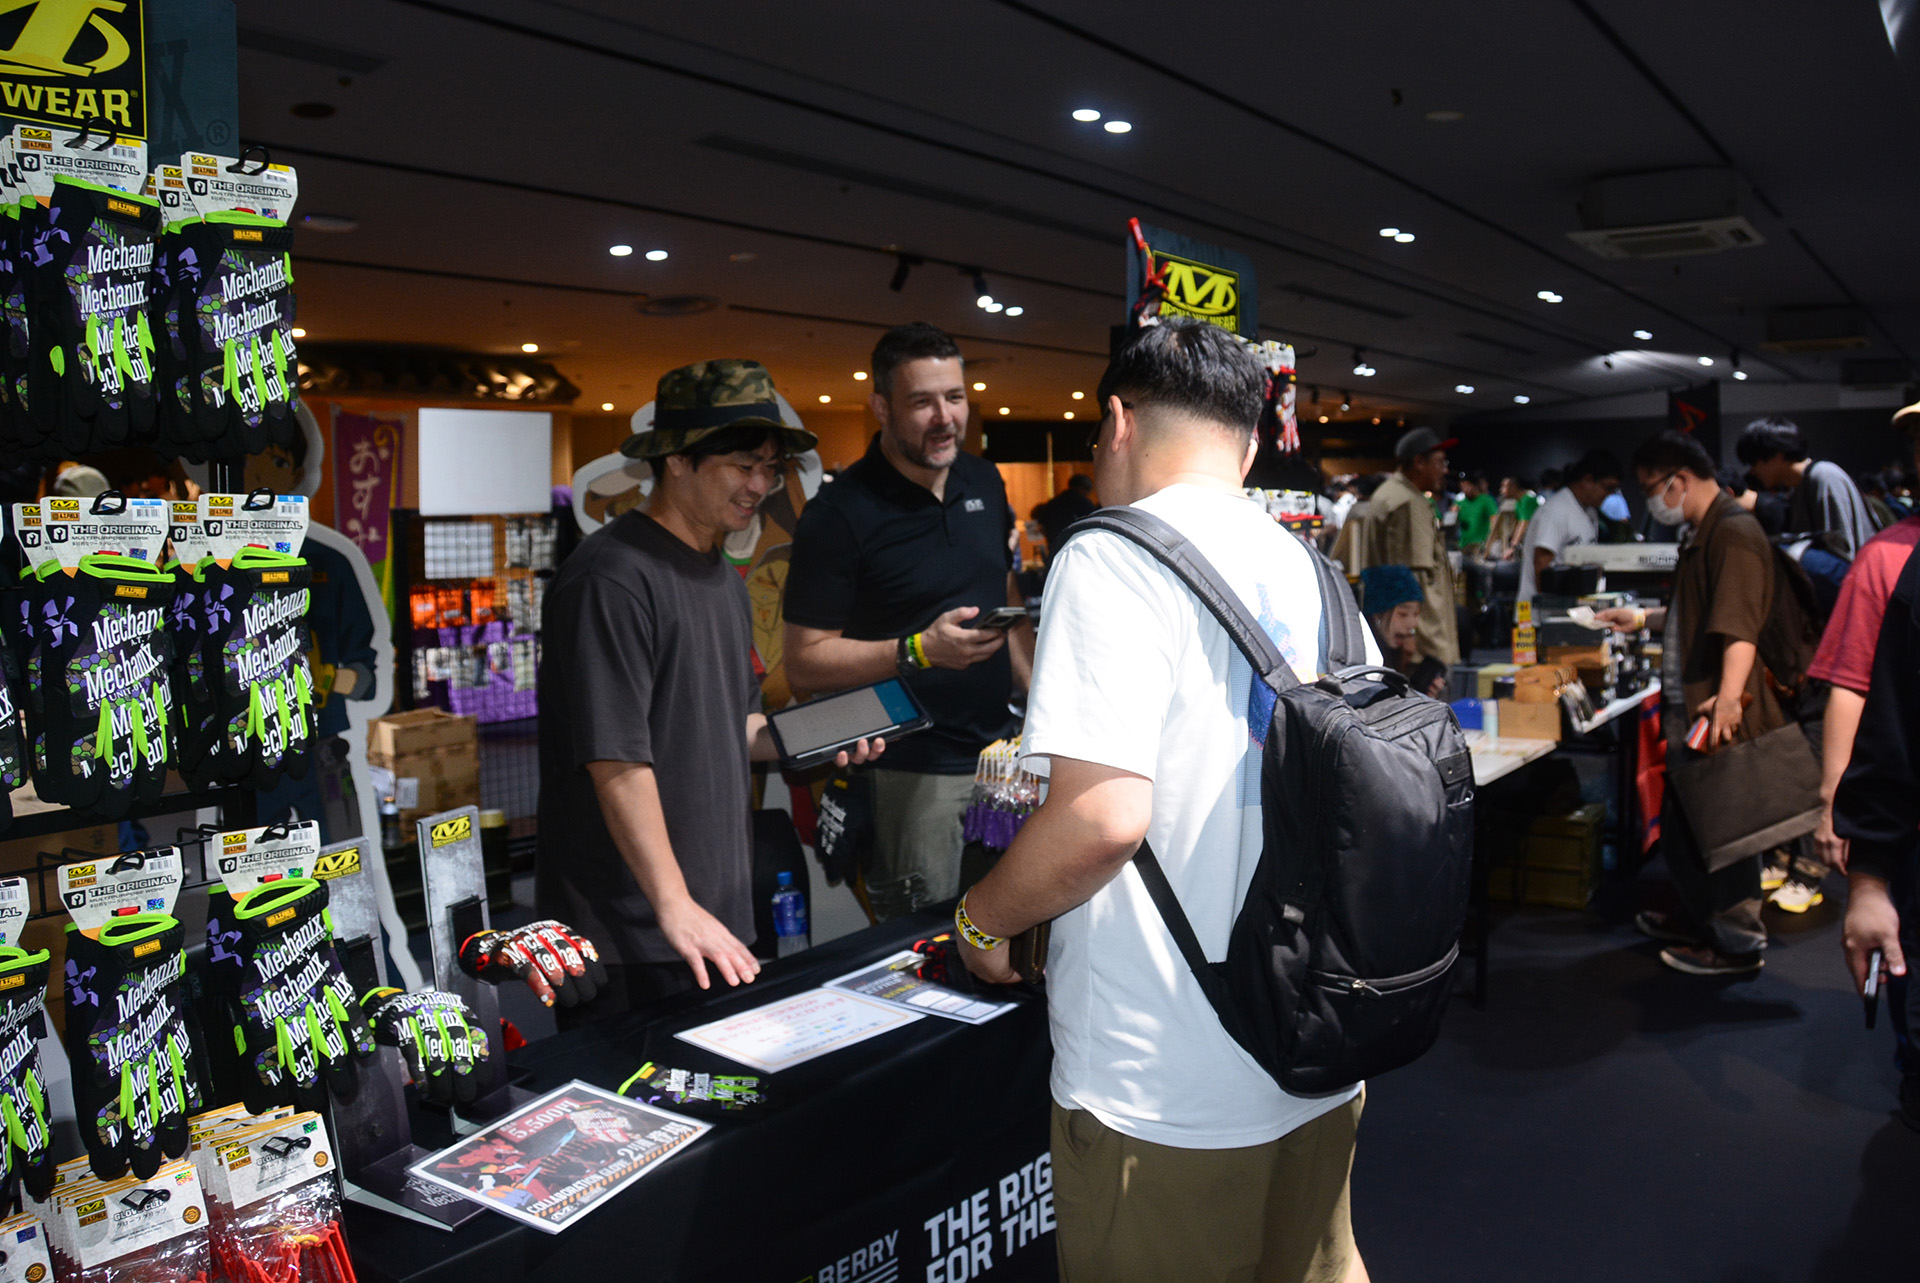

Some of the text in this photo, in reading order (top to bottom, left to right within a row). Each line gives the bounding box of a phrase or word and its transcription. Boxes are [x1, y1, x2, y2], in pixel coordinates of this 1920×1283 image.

[0, 81, 132, 128] WEAR
[43, 154, 141, 176] THE ORIGINAL
[210, 180, 292, 199] THE ORIGINAL
[80, 275, 146, 313] Mechanix
[220, 256, 285, 303] Mechanix
[213, 296, 279, 342] Mechanix
[71, 524, 162, 536] THE ORIGINAL
[225, 520, 303, 530] THE ORIGINAL
[242, 587, 307, 638] Mechanix
[84, 642, 160, 702] Mechanix
[235, 626, 299, 684] Mechanix
[239, 846, 315, 864] THE ORIGINAL
[89, 875, 178, 897] THE ORIGINAL
[254, 913, 326, 983] Mechanix
[307, 932, 327, 951] FIELD
[116, 952, 181, 1024] Mechanix
[255, 952, 327, 1024] Mechanix
[105, 994, 172, 1070] Mechanix
[924, 1152, 1053, 1259] THE RIG
[818, 1229, 899, 1283] BERRY
[926, 1191, 1057, 1283] FOR THE
